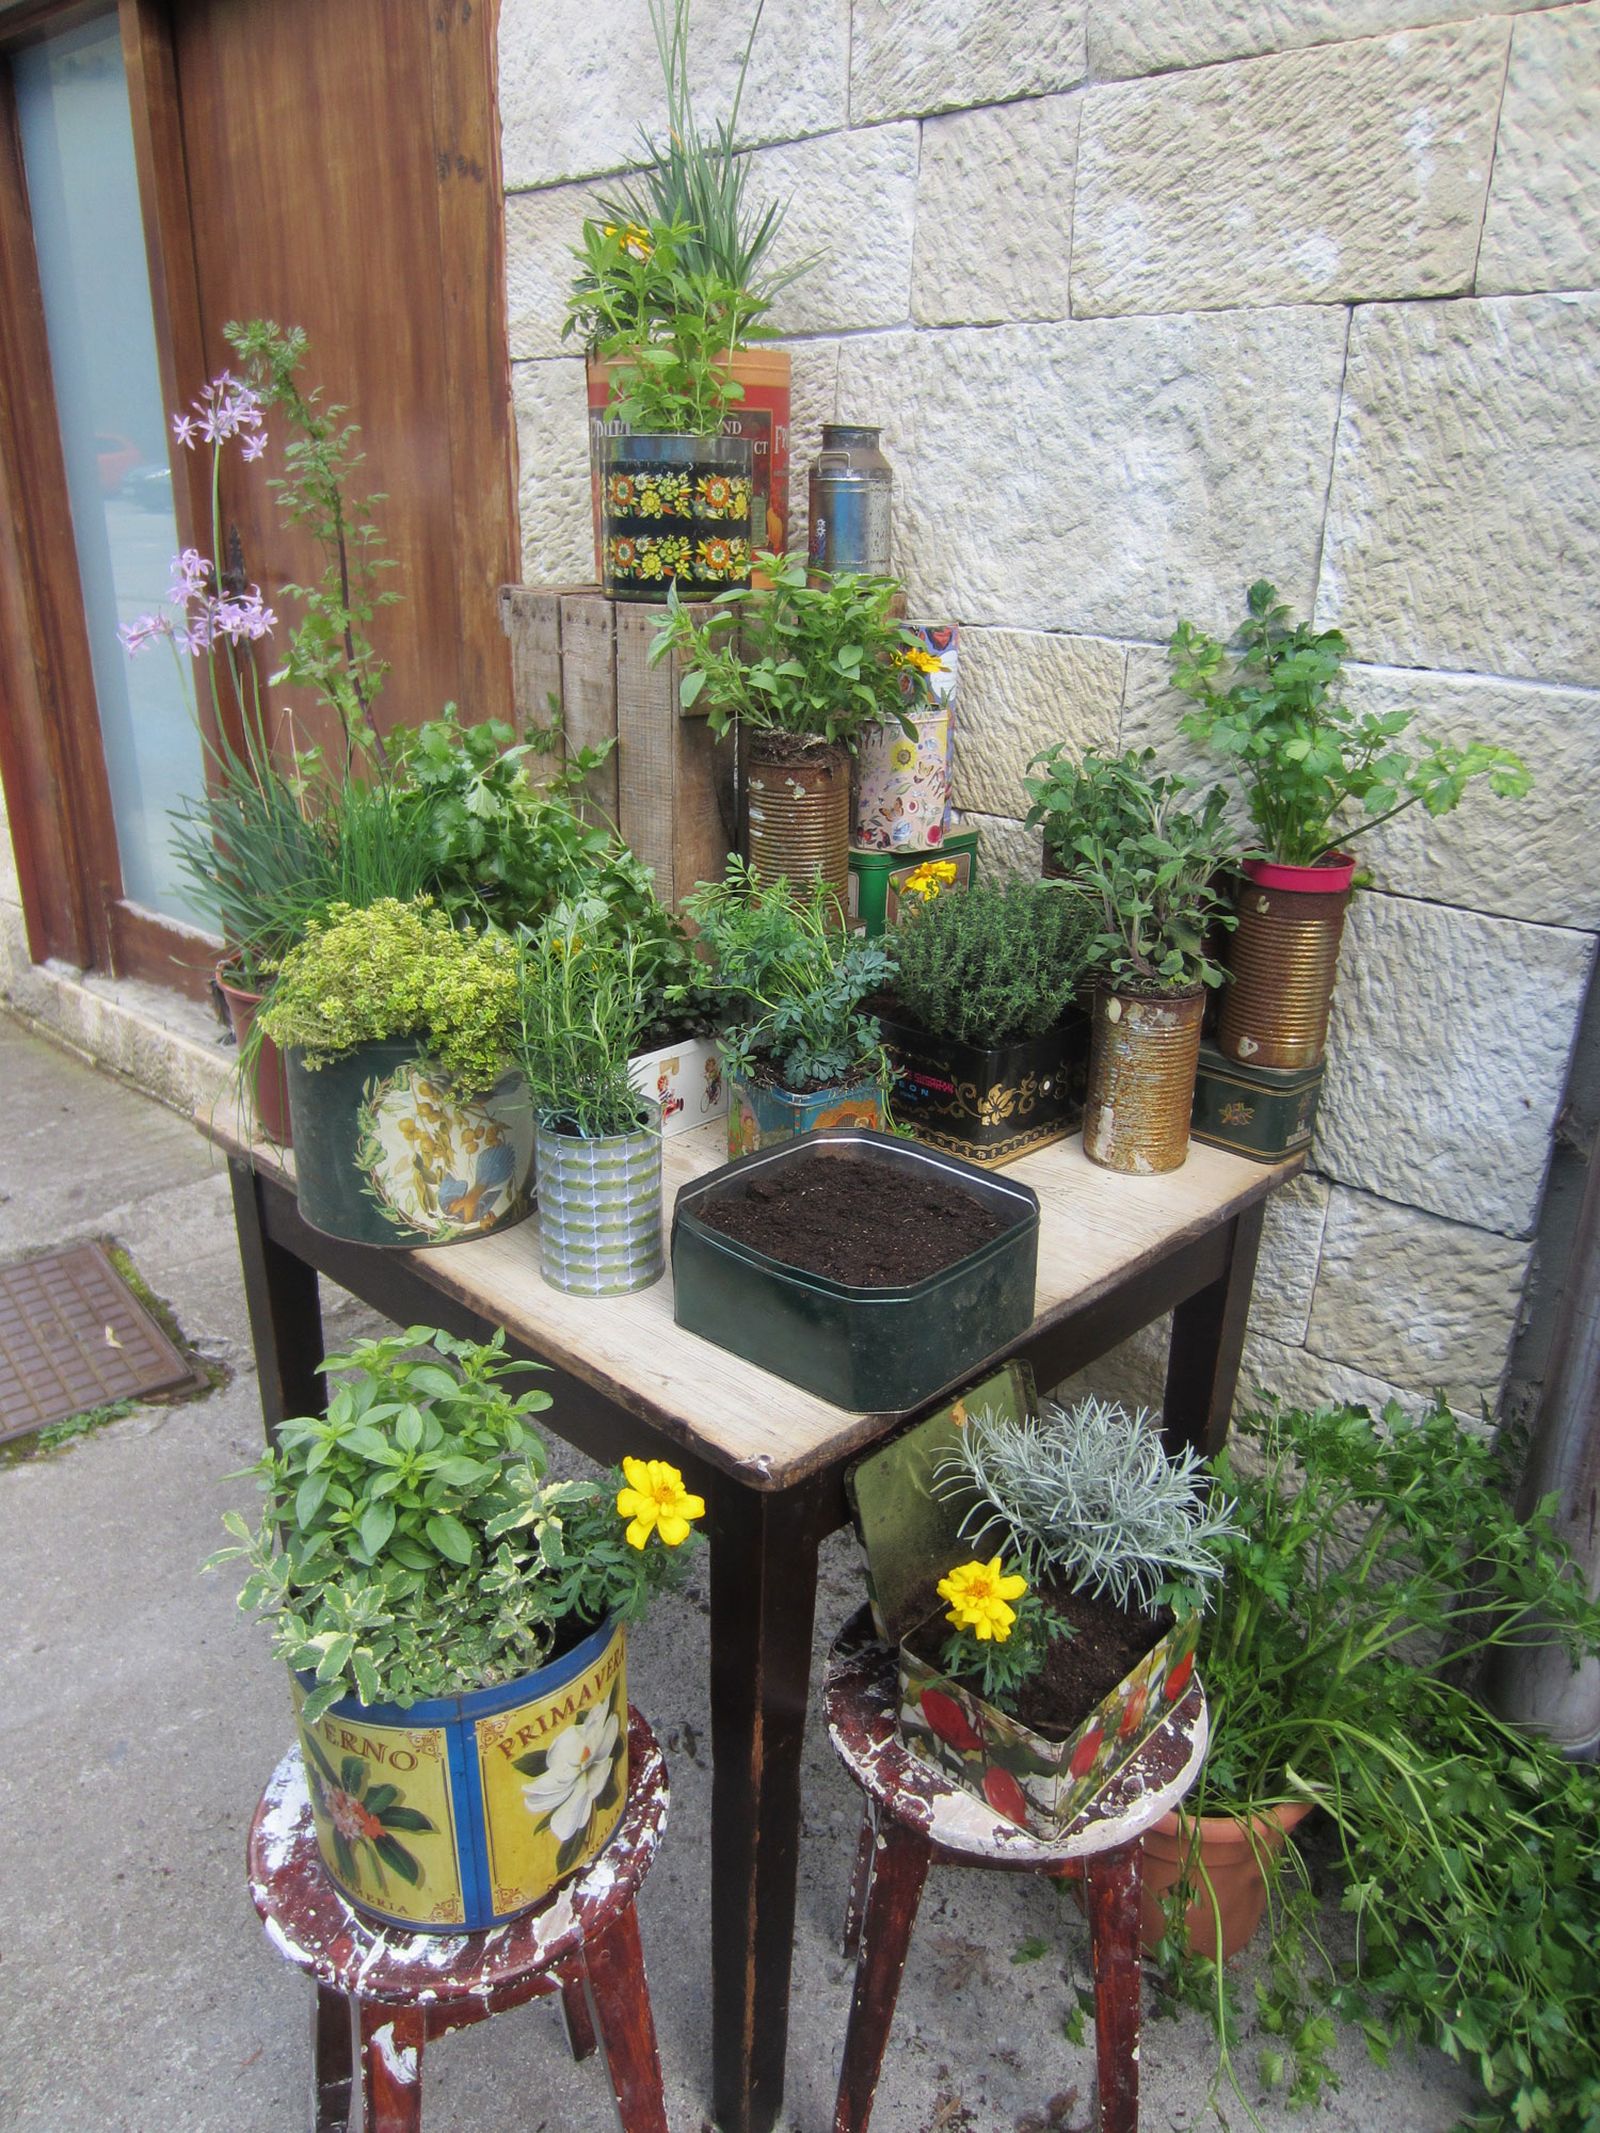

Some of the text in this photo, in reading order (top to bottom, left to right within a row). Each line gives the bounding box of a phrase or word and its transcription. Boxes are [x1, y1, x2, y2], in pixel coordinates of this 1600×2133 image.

[721, 420, 742, 435] ND
[753, 440, 769, 455] CT
[498, 1640, 624, 1760] PRIMAVERA
